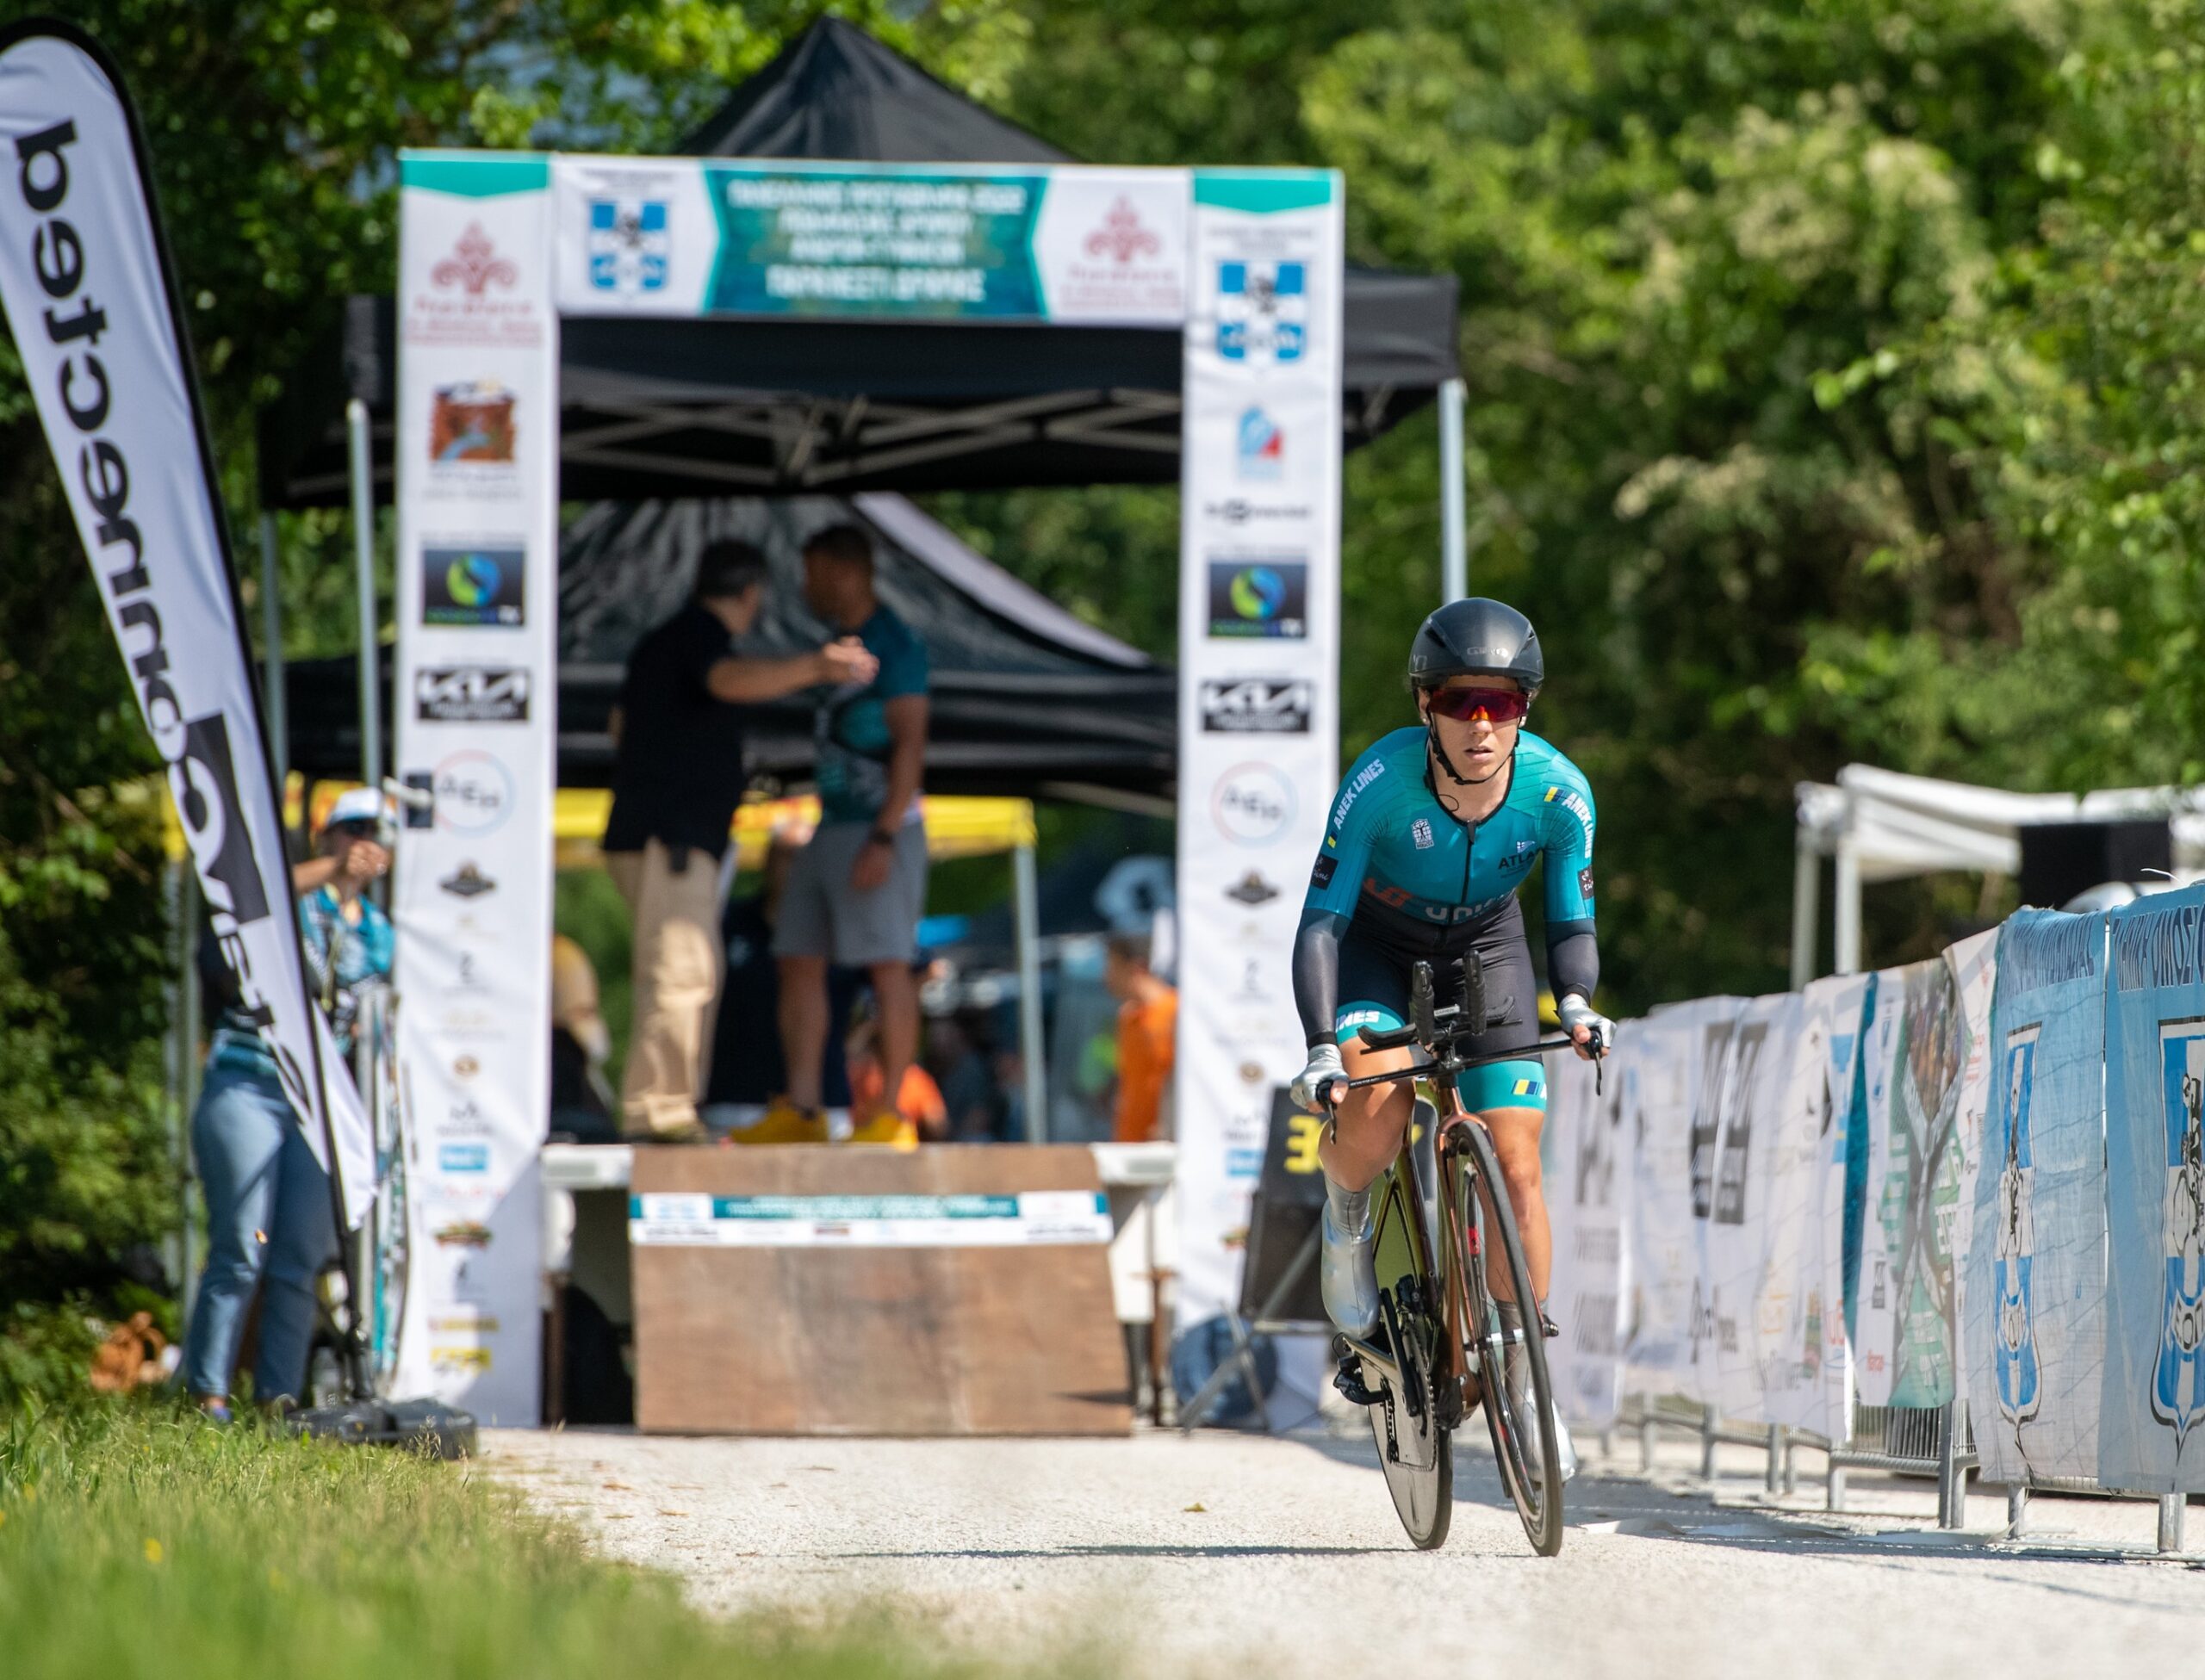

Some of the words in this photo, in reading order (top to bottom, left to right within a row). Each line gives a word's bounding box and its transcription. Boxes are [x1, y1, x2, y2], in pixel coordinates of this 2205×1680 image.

[1334, 787, 1357, 829] ANEK
[1352, 759, 1385, 793] LINES
[1498, 849, 1538, 869] ATLA
